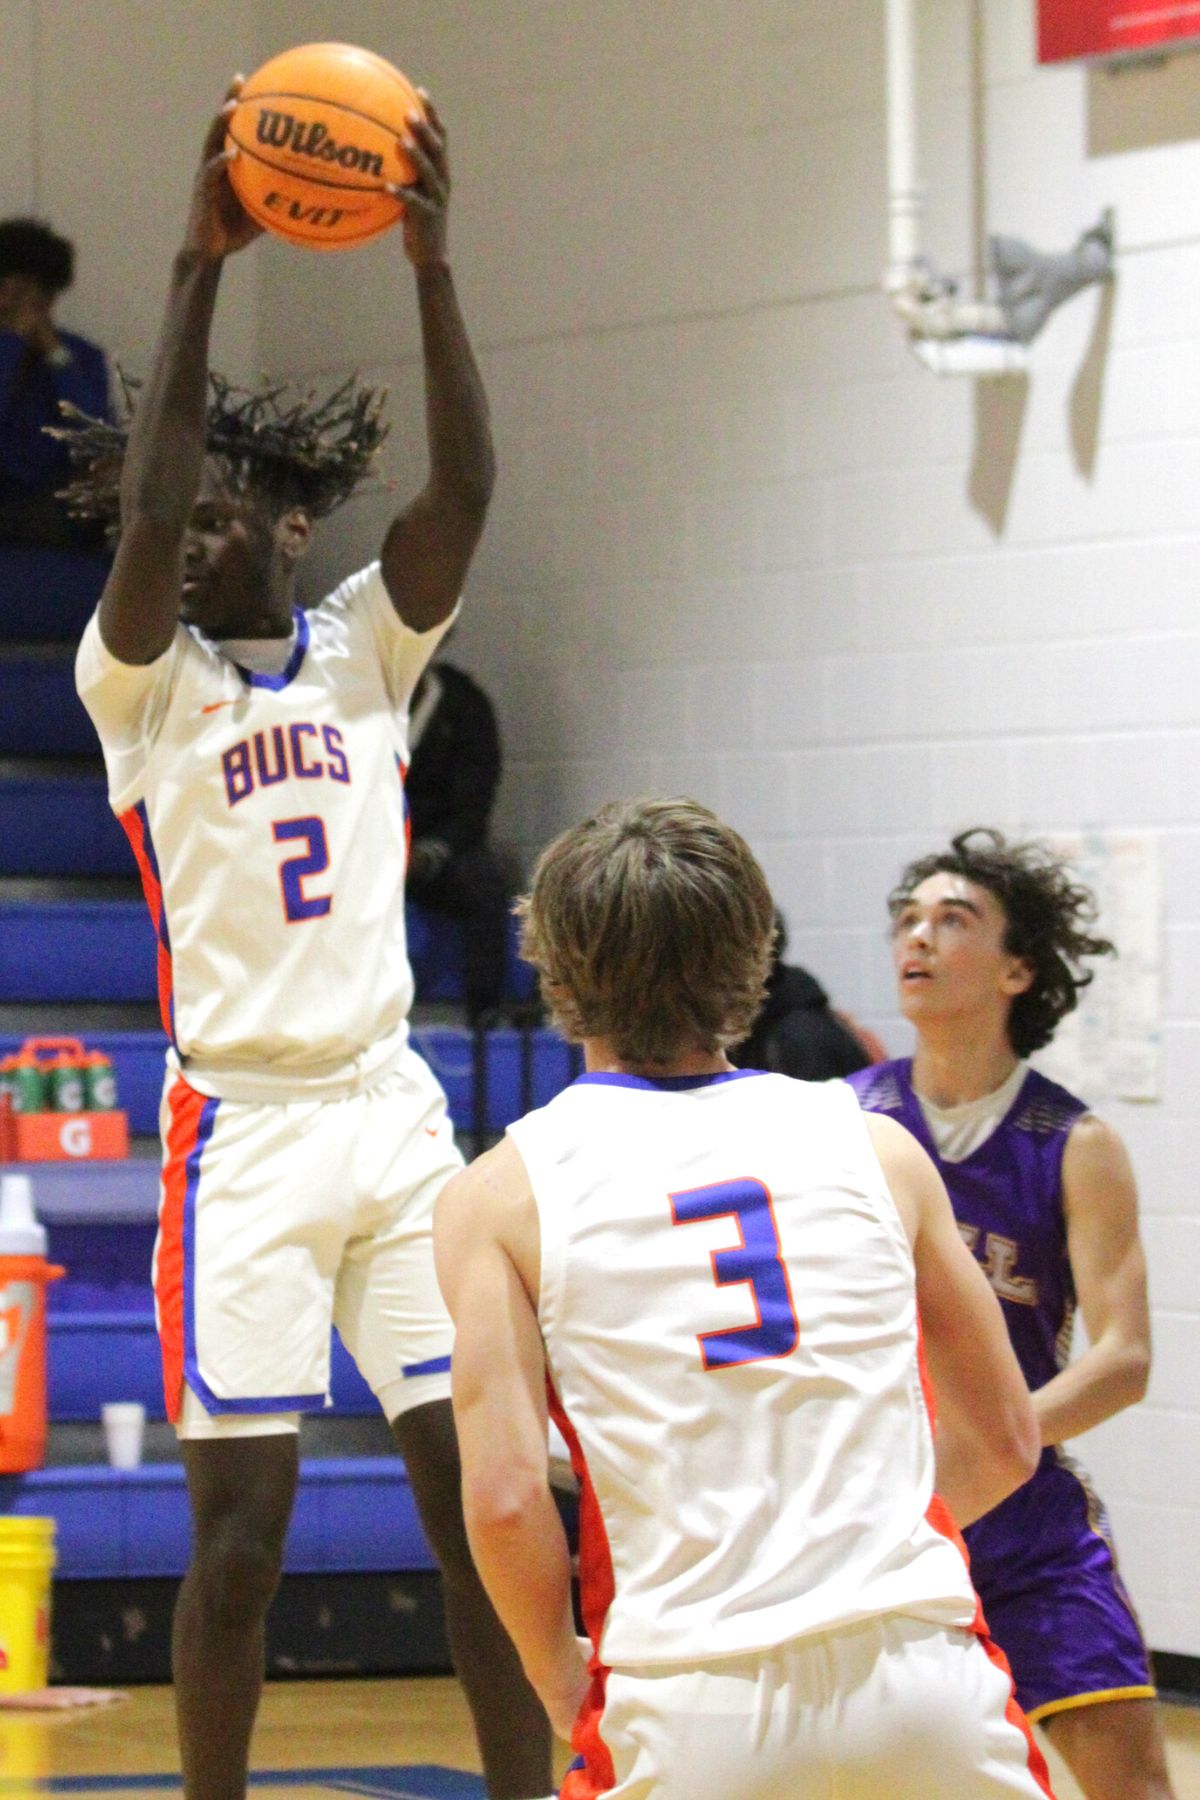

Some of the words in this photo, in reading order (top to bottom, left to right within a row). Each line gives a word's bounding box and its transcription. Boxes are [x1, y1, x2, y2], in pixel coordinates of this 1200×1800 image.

[256, 108, 384, 177] Wilson
[221, 721, 352, 809] BUCS
[271, 814, 333, 925] 2
[59, 1118, 92, 1158] G
[667, 1176, 800, 1372] 3
